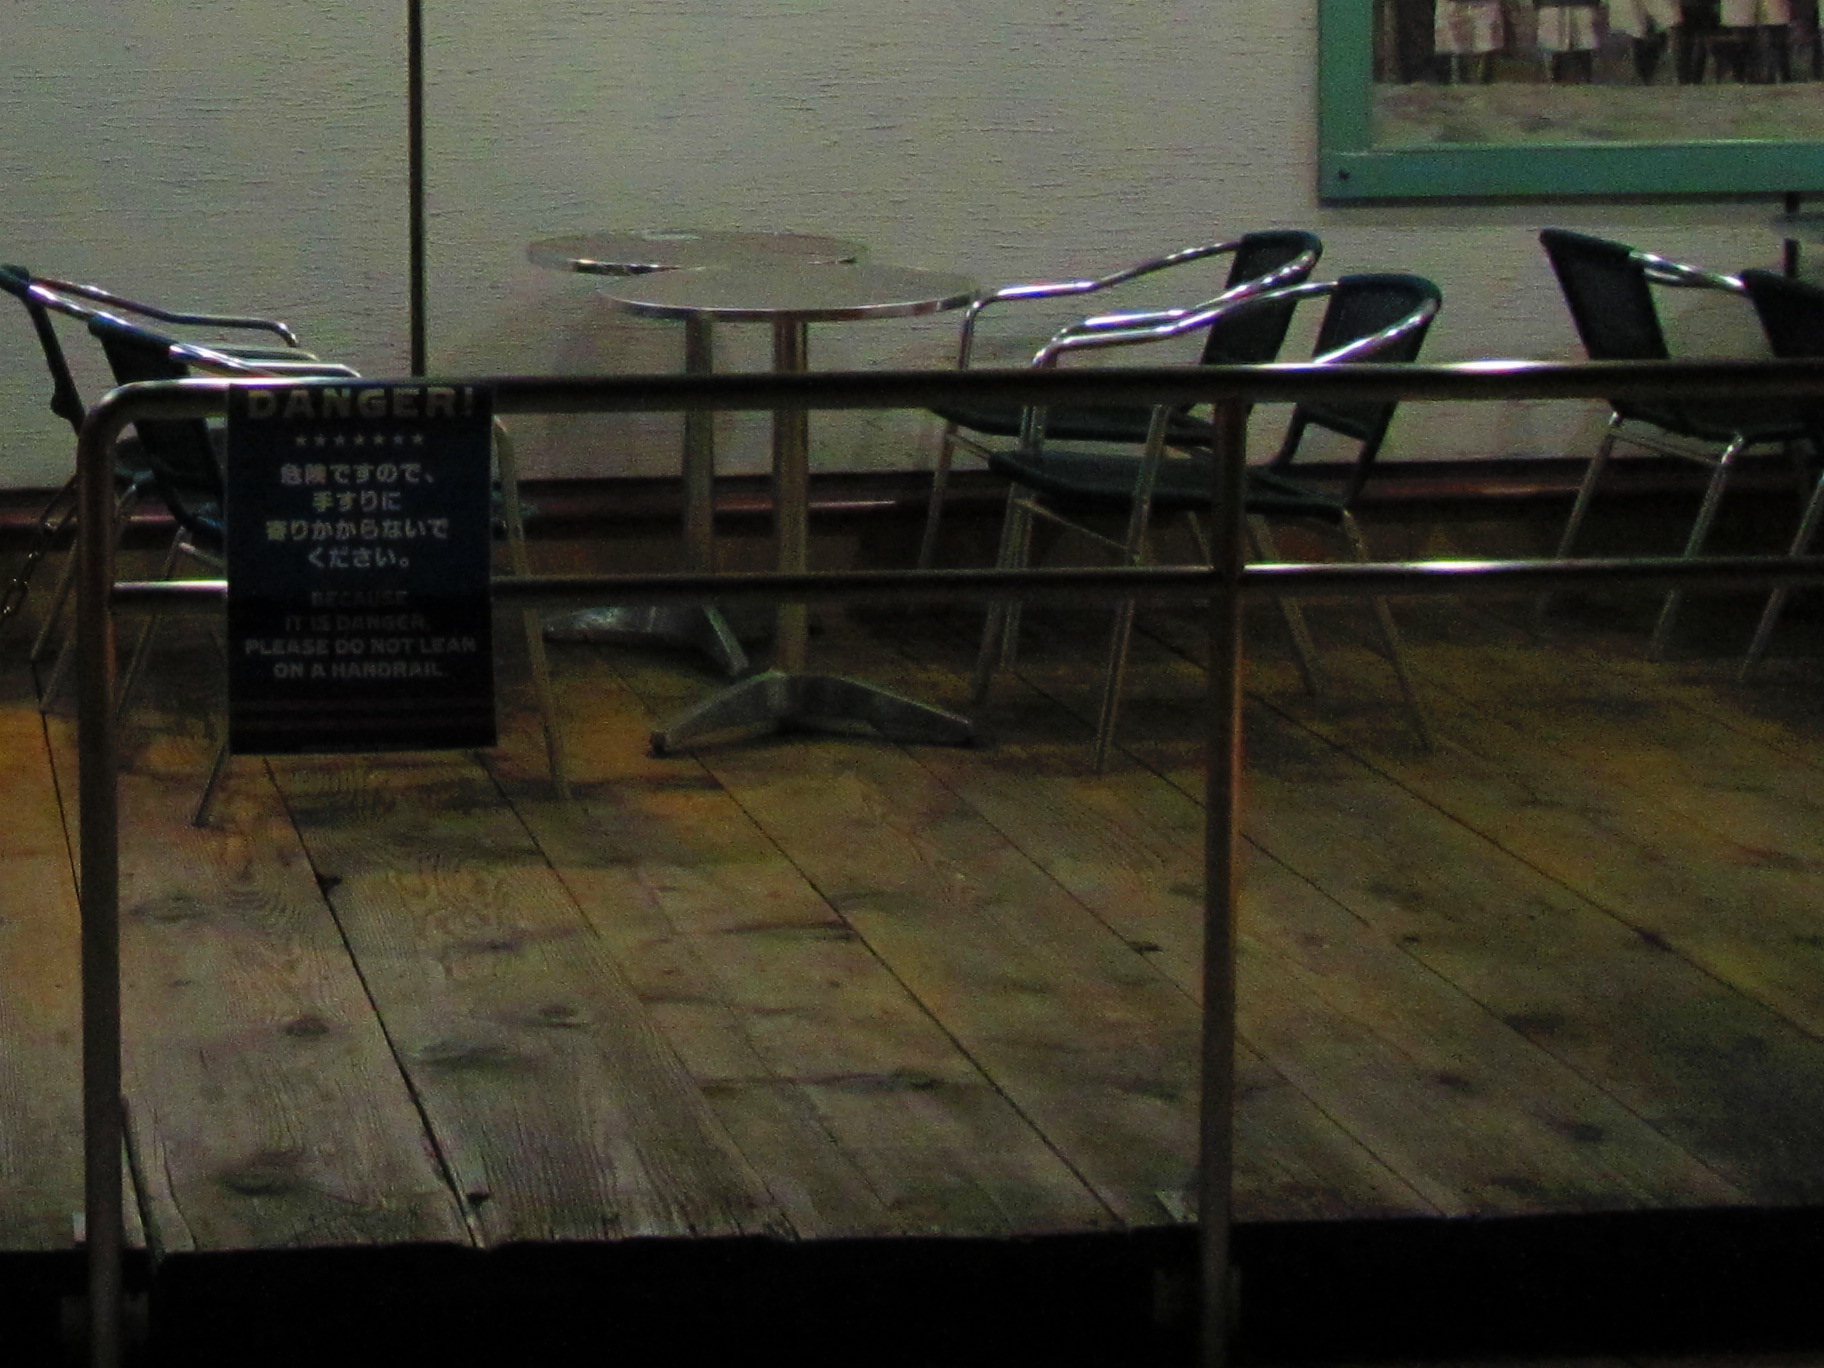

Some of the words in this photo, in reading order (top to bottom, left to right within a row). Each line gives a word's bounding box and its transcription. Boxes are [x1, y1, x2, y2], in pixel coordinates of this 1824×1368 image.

[247, 387, 474, 419] DANGER!
[244, 637, 329, 656] PLEASE
[334, 637, 365, 655] DO
[370, 637, 414, 655] NOT
[419, 636, 478, 654] LEAN
[272, 662, 304, 680] ON
[310, 662, 327, 680] A
